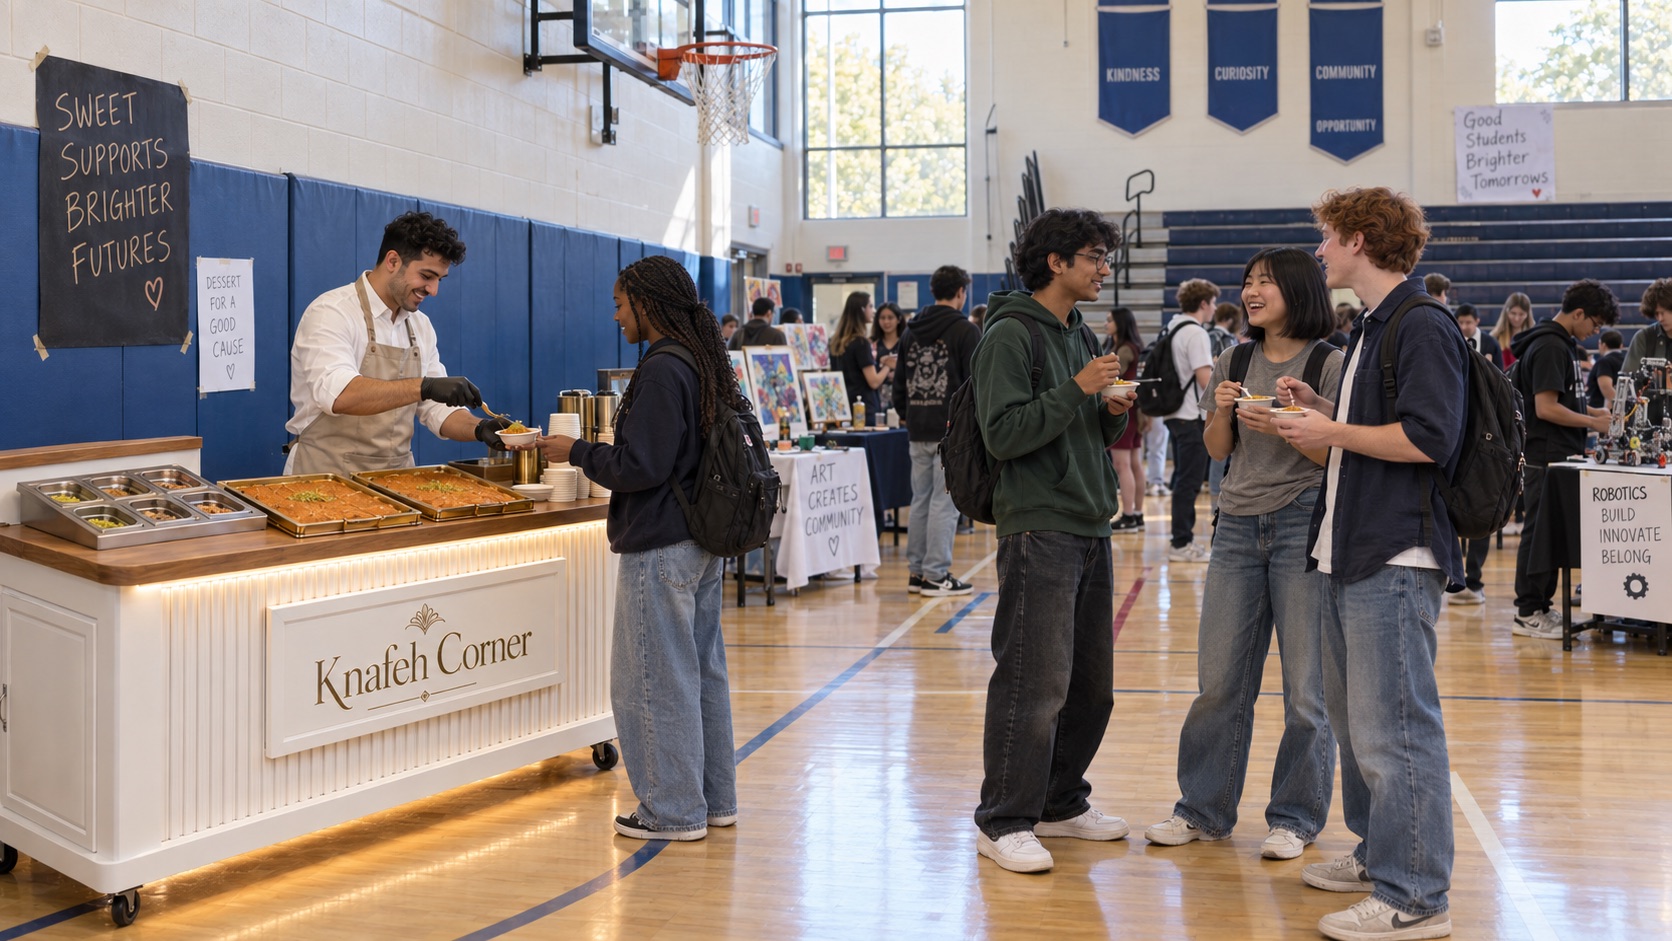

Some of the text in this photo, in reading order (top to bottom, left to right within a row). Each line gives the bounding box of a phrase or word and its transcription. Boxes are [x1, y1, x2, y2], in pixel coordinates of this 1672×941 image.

[1107, 67, 1160, 82] KINDNESS
[1215, 66, 1269, 80] CURIOSITY
[1316, 65, 1376, 79] COMMUNITY
[55, 91, 137, 131] SWEET
[1463, 109, 1503, 130] Good
[1317, 119, 1376, 132] OPPORTUNITY
[1466, 129, 1527, 149] Students
[61, 138, 167, 180] SUPPORTS
[1466, 150, 1529, 173] Brighter
[1470, 172, 1549, 190] Tomorrows
[65, 182, 174, 233] BRIGHTER
[72, 230, 171, 285] FUTURES
[206, 275, 241, 290] DESSERT
[210, 296, 236, 310] FOR A
[210, 317, 236, 334] GOOD
[212, 337, 244, 358] CAUSE
[810, 462, 836, 486] ART
[808, 484, 858, 510] CREATES
[1593, 486, 1647, 502] ROBOTICS
[805, 507, 864, 536] COMMUNITY
[1602, 508, 1635, 523] BUILD
[1600, 527, 1661, 543] INNOVATE
[1602, 548, 1652, 565] BELONG
[314, 631, 533, 710] Knafeh Corner
